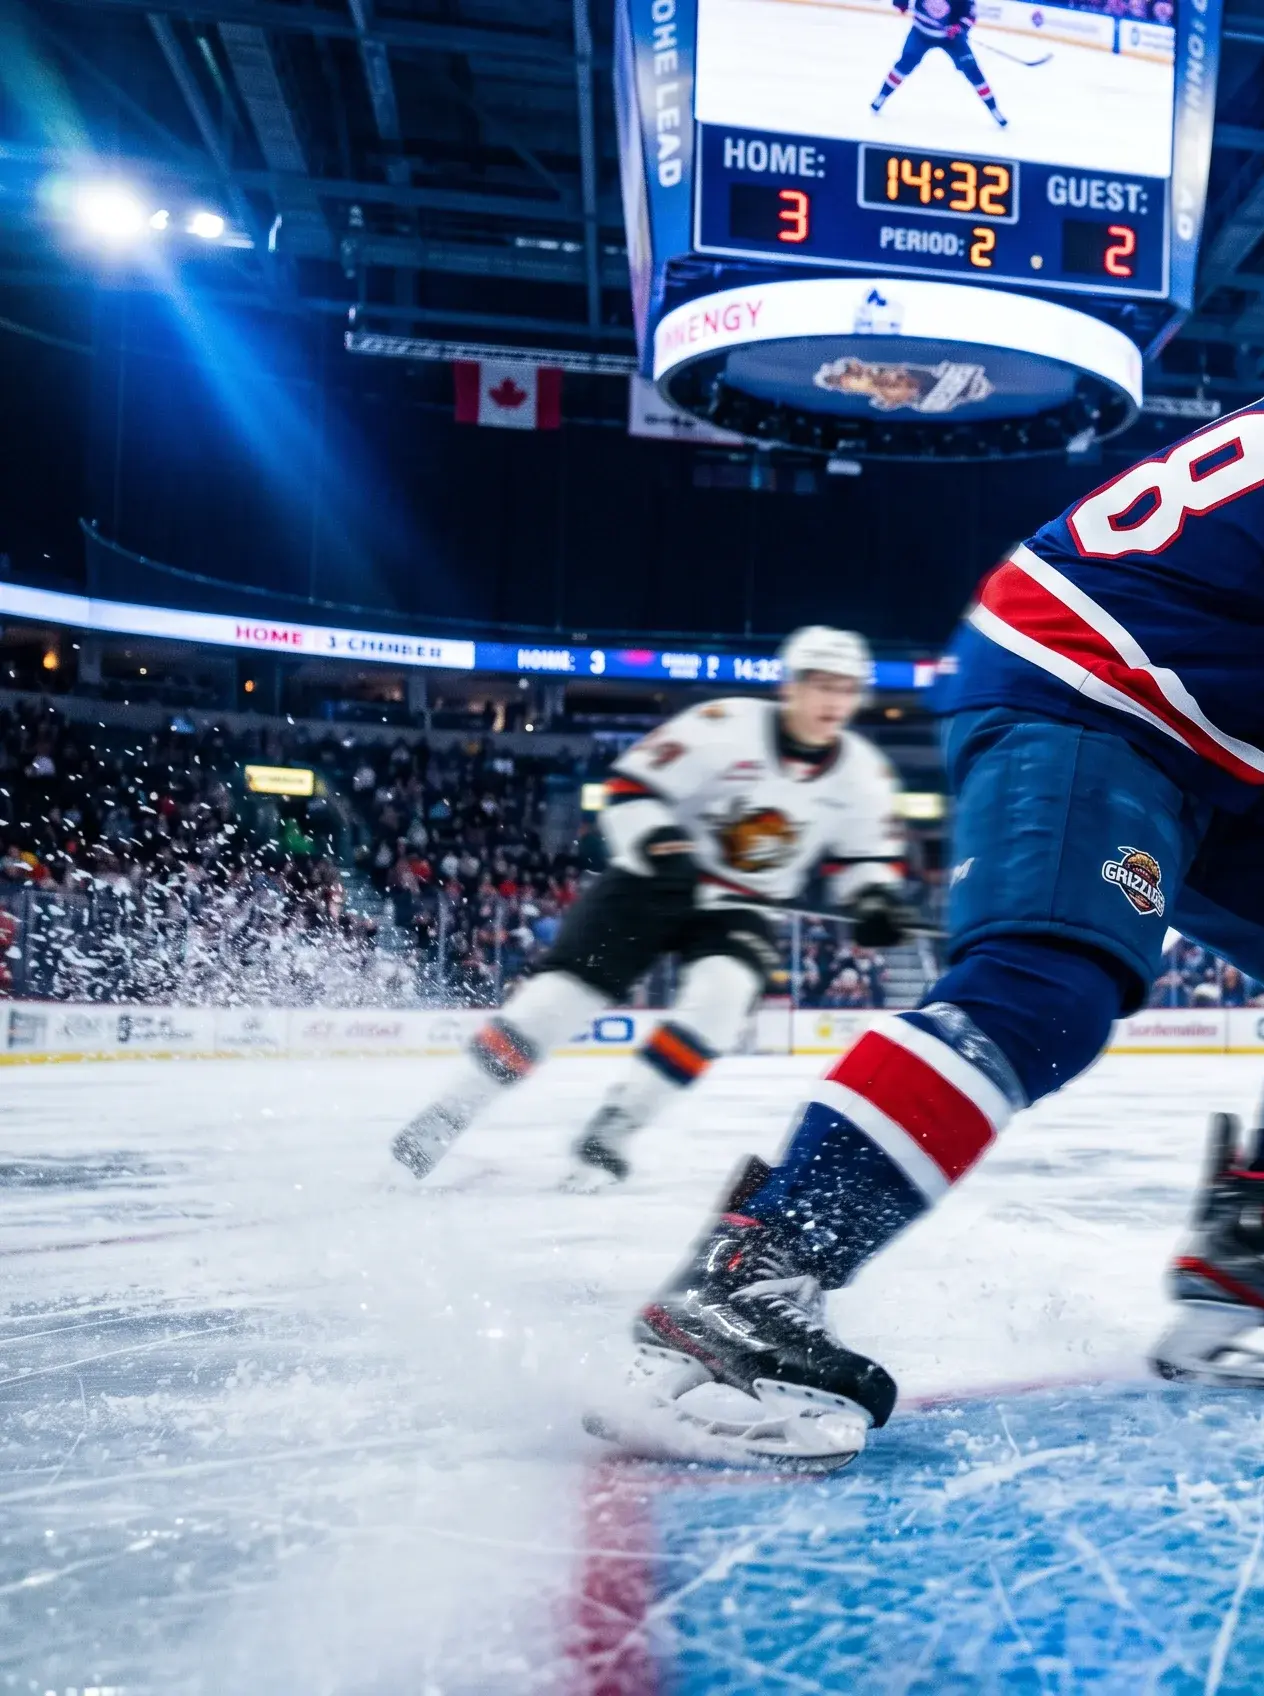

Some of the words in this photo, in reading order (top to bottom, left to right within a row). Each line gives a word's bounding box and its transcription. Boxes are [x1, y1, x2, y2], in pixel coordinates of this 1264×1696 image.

[655, 82, 682, 188] LEAD
[723, 137, 825, 178] HOME:
[887, 157, 1010, 215] 14:32
[1047, 174, 1148, 215] GUEST:
[778, 188, 809, 243] 3
[880, 226, 965, 257] PERIOD:
[970, 227, 996, 268] 2
[1103, 224, 1136, 278] 2
[235, 624, 303, 646] HOME
[589, 650, 606, 674] 3
